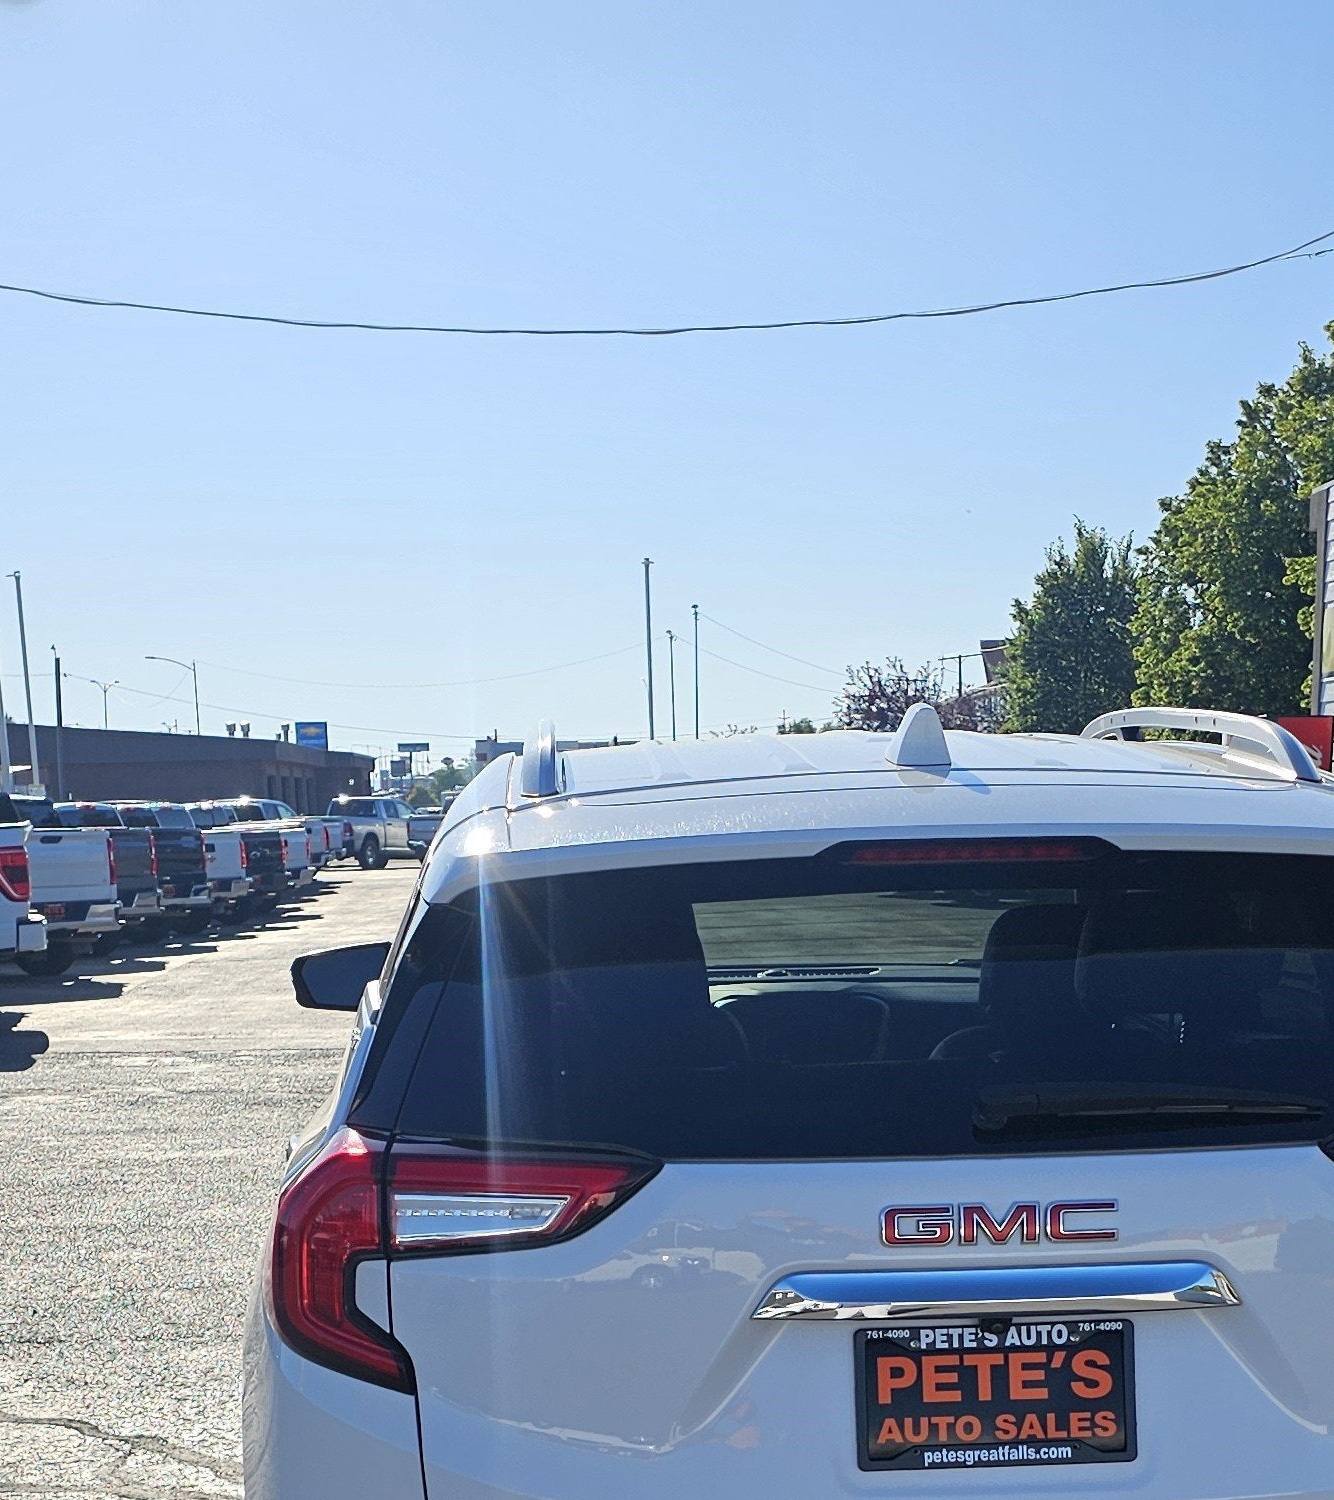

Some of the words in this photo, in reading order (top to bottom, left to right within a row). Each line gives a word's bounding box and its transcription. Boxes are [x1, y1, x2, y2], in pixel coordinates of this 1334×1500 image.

[880, 1199, 1119, 1247] GMC
[866, 1329, 910, 1339] 761-4090
[919, 1328, 998, 1349] PETE'S
[1004, 1324, 1069, 1347] AUTO
[1078, 1321, 1123, 1332] 761-4090
[876, 1350, 1114, 1404] PETE'S
[876, 1414, 982, 1444] AUTO
[994, 1410, 1117, 1440] SALES
[923, 1444, 1072, 1467] petesgreatfalls.com
